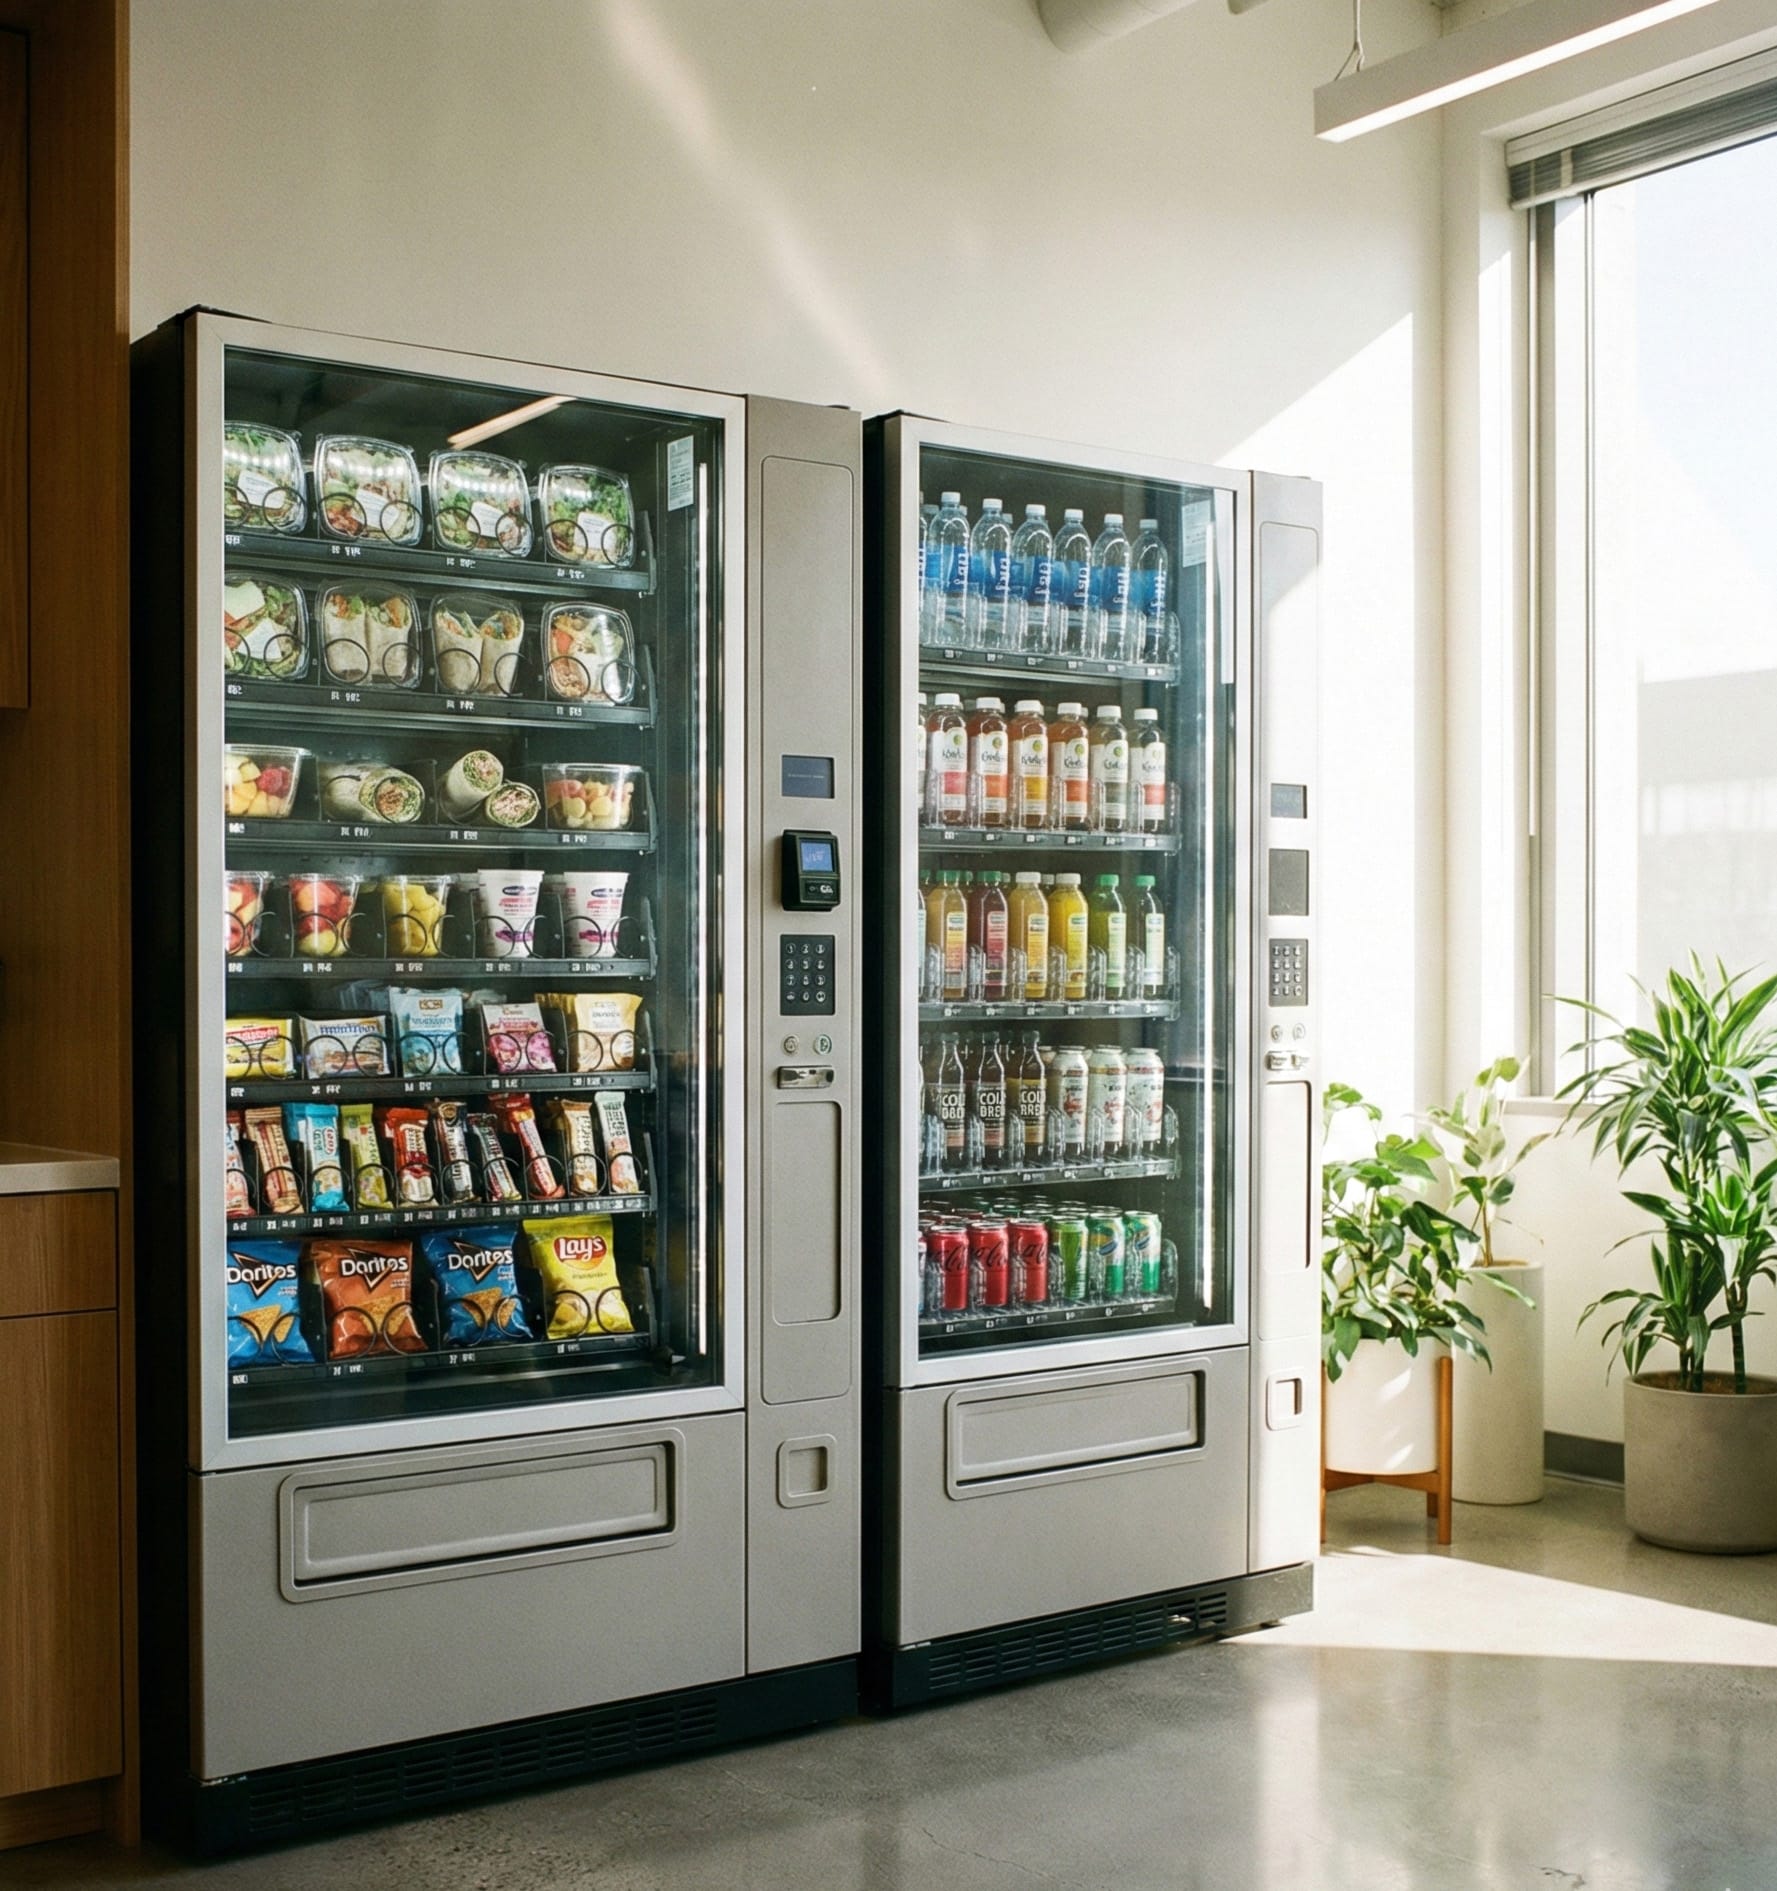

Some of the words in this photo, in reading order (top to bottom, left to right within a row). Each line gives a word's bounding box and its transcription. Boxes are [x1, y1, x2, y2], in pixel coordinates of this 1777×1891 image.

[559, 1235, 604, 1262] Lay's
[340, 1256, 409, 1277] Doritos
[447, 1249, 514, 1271] Doritos
[227, 1264, 296, 1284] Doritos
